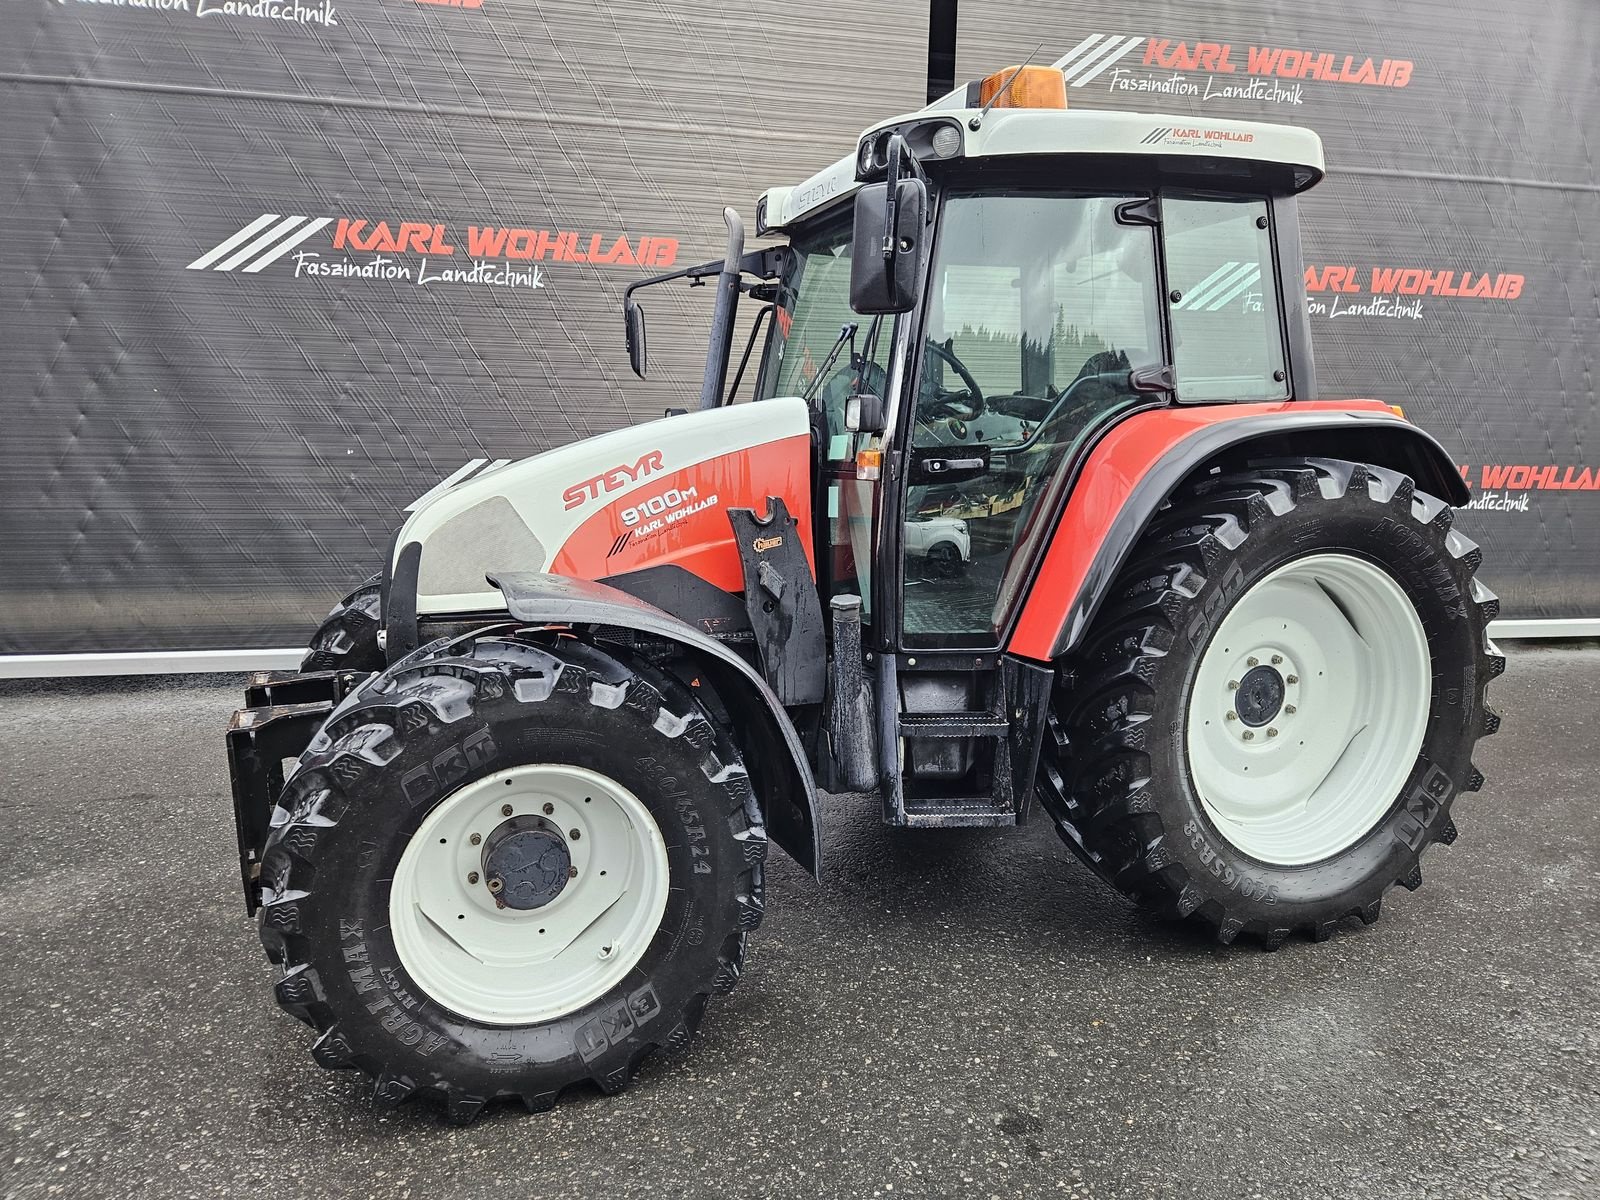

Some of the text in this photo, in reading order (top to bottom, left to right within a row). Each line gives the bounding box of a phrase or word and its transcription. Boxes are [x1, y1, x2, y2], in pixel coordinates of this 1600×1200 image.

[196, 0, 338, 26] Landtechnik
[1144, 38, 1414, 88] KARL WOHLLAIB
[1108, 67, 1304, 106] Faszination Landtechnik
[1172, 128, 1255, 143] KARL WOHLLAIB
[332, 217, 679, 268] KARL WOHLLAIB
[291, 249, 545, 289] Faszination Landtechnik
[1304, 264, 1525, 300] ARL WOHLLAIB
[1329, 294, 1424, 320] Landtechnik
[562, 449, 665, 512] STEYR
[620, 486, 698, 527] 9100M
[634, 494, 719, 538] KARL WOHLLAIB
[1450, 491, 1530, 512] ndtechnik
[400, 725, 498, 809] BKT
[1392, 762, 1454, 853] BKT
[573, 981, 661, 1065] BKT
